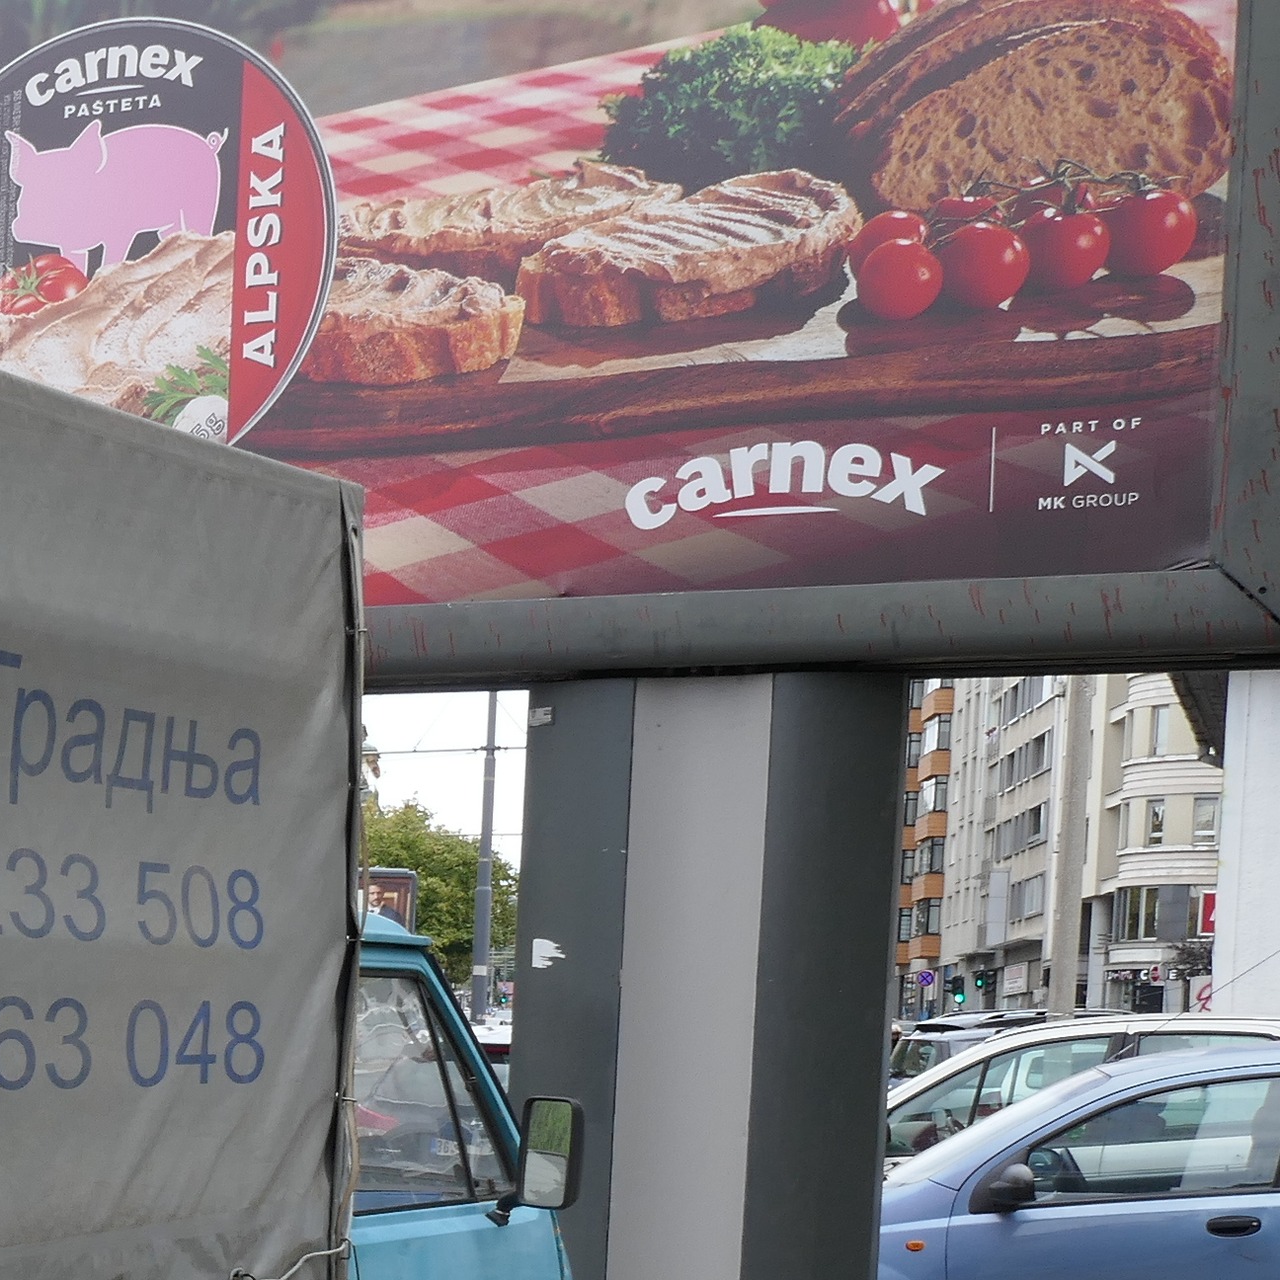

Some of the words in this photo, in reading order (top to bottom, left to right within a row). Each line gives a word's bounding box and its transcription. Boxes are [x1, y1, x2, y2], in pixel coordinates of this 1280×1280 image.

[24, 44, 203, 106] carnex
[64, 94, 162, 118] PAŠTETA
[243, 122, 285, 368] ALPSKA
[1041, 419, 1099, 435] PART
[1112, 417, 1143, 431] OF
[625, 440, 946, 530] carnex
[1038, 496, 1066, 511] MK
[1071, 492, 1140, 508] GROUP
[136, 861, 265, 950] 508
[125, 999, 266, 1089] 048
